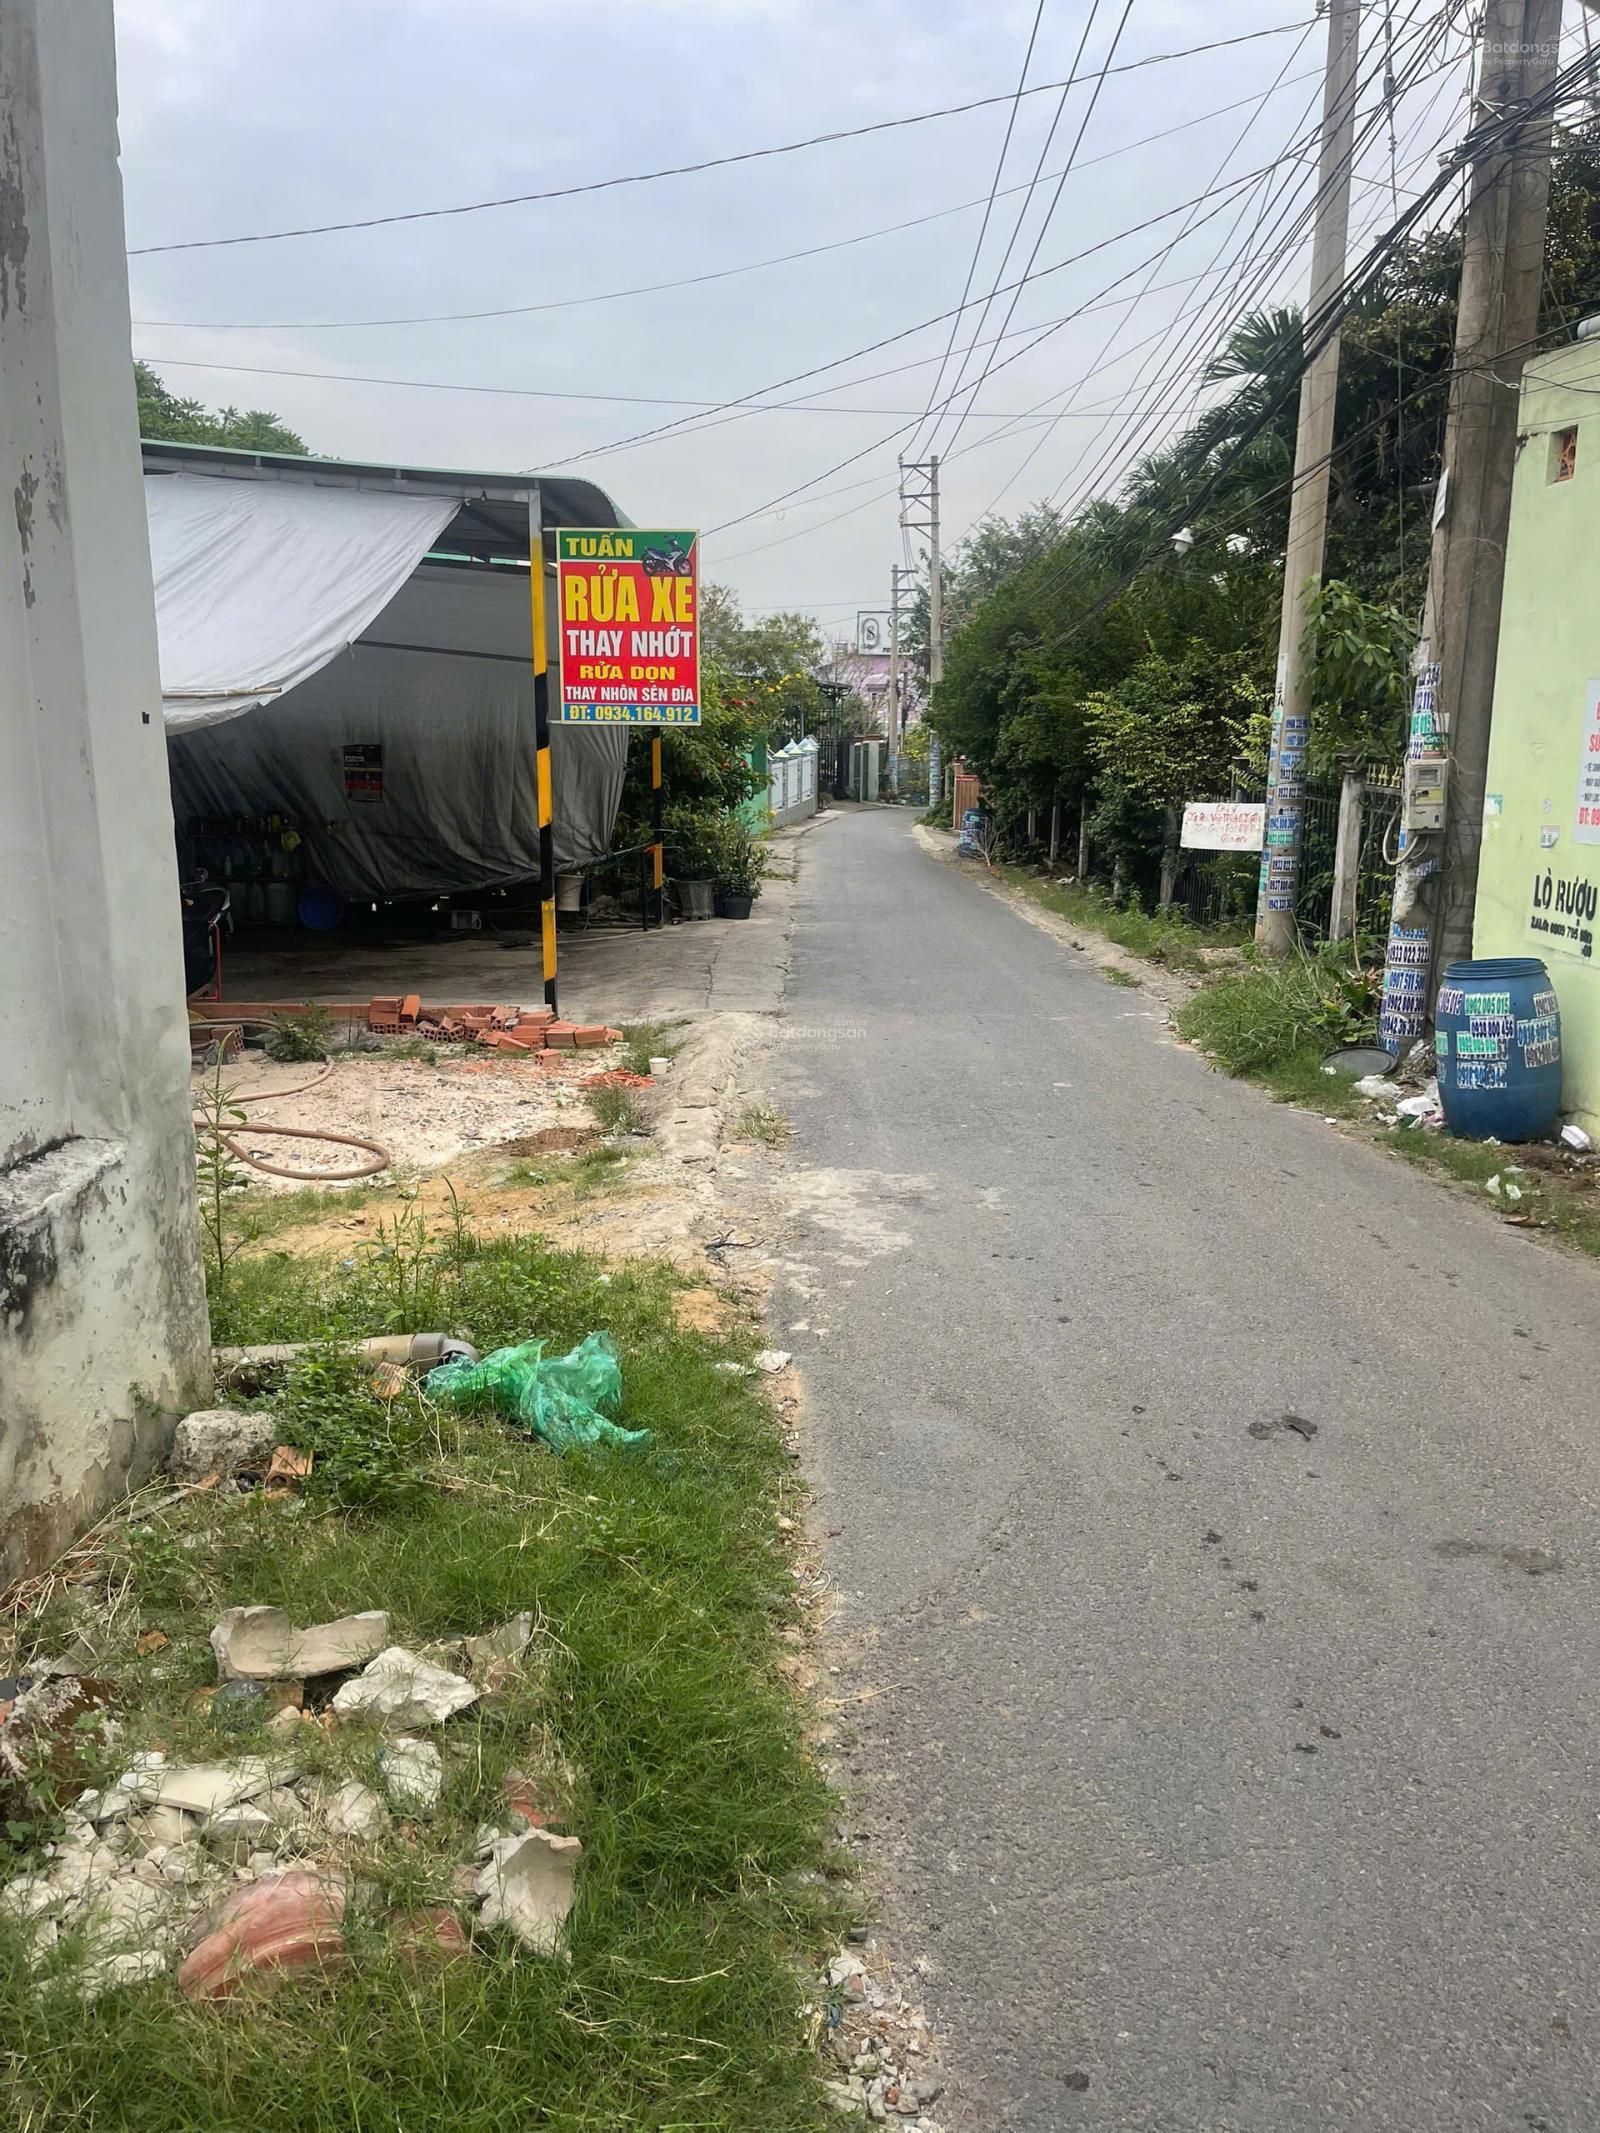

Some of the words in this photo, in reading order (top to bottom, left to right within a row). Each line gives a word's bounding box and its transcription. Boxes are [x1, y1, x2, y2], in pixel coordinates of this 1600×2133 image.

[566, 532, 634, 557] TUẤN
[565, 564, 640, 623] RỬA
[651, 576, 694, 623] XE
[566, 630, 623, 657] THAY
[631, 625, 693, 658] NHỚT
[580, 661, 624, 680] RỬA
[630, 666, 675, 683] DỌN
[566, 686, 597, 700] THAY
[601, 684, 638, 701] NHÔN
[642, 685, 669, 702] SÊN
[672, 685, 694, 702] ĐĨA
[569, 705, 591, 720] ĐT:
[595, 705, 693, 722] 0934.164.912
[1533, 867, 1552, 909] LÒ
[1555, 876, 1598, 926] RƯỢU
